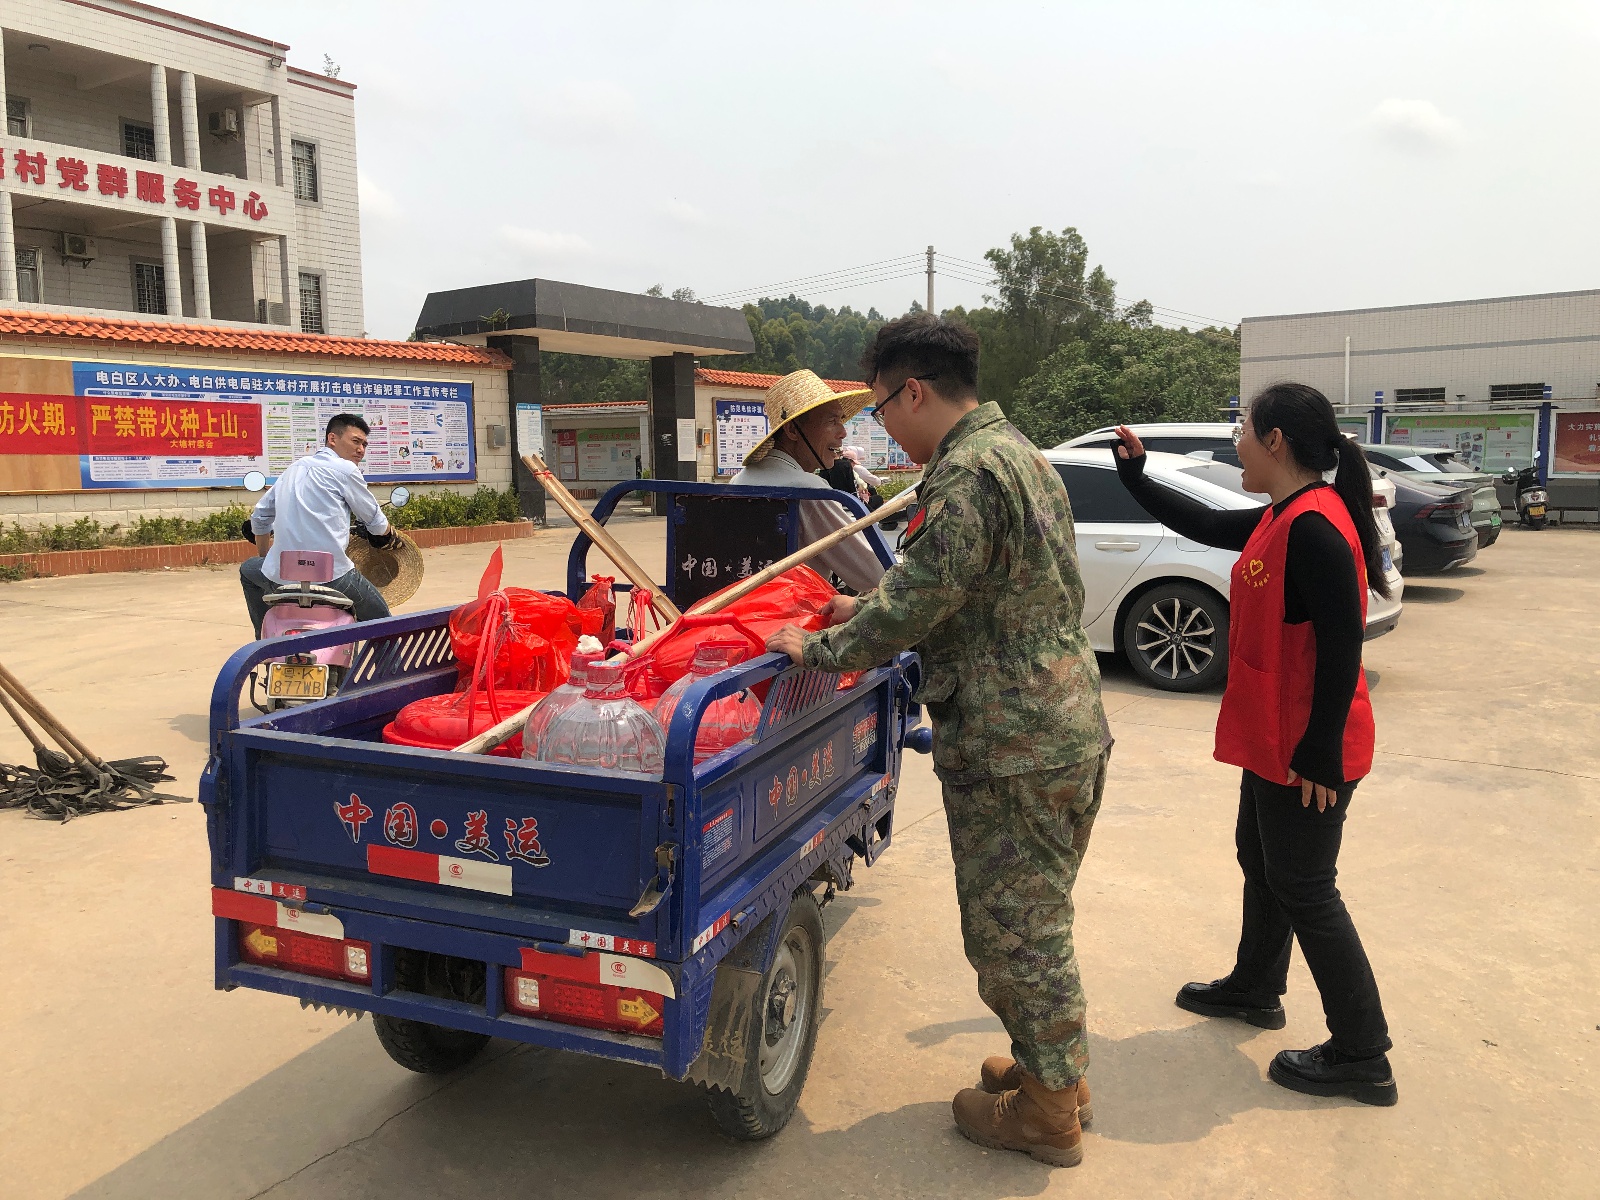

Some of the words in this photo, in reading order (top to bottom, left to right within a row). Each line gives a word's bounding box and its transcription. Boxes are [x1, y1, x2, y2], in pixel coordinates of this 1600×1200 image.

[0, 148, 268, 221] 村党群服务中心
[170, 439, 214, 449] 大塘村委会
[274, 681, 321, 695] 877WB
